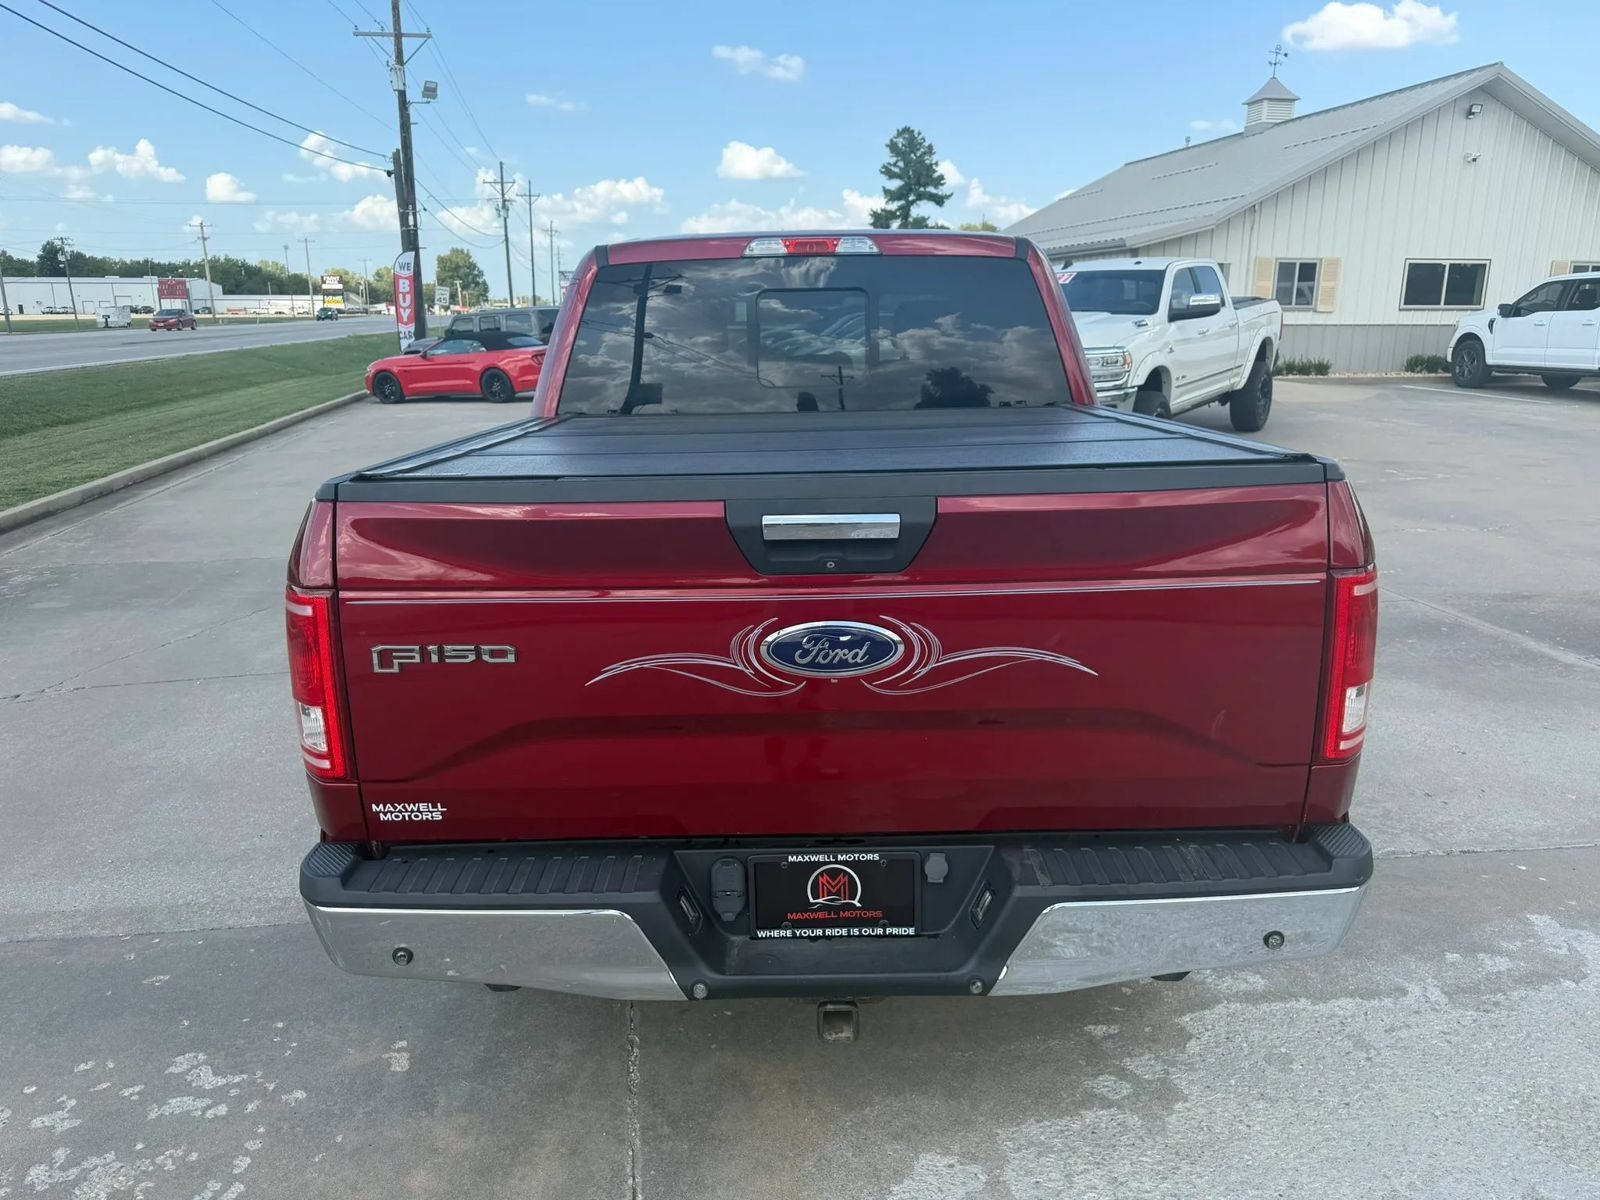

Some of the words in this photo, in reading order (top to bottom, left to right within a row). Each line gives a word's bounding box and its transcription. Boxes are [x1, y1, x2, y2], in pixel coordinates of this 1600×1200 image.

[398, 262, 412, 272] WE
[398, 278, 412, 322] BUY
[794, 633, 871, 664] Ford
[371, 802, 448, 812] MAXWELL
[379, 811, 443, 821] MOTORS
[788, 855, 836, 863] MAXWELL
[837, 853, 880, 862] MOTORS
[787, 911, 838, 920] MAXWELL
[839, 910, 883, 919] MOTORS
[757, 929, 793, 938] WHERE
[794, 928, 823, 937] YOUR
[825, 928, 848, 937] RIDE
[850, 928, 860, 936] IS
[861, 928, 884, 936] OUR
[885, 927, 915, 935] PRIDE
